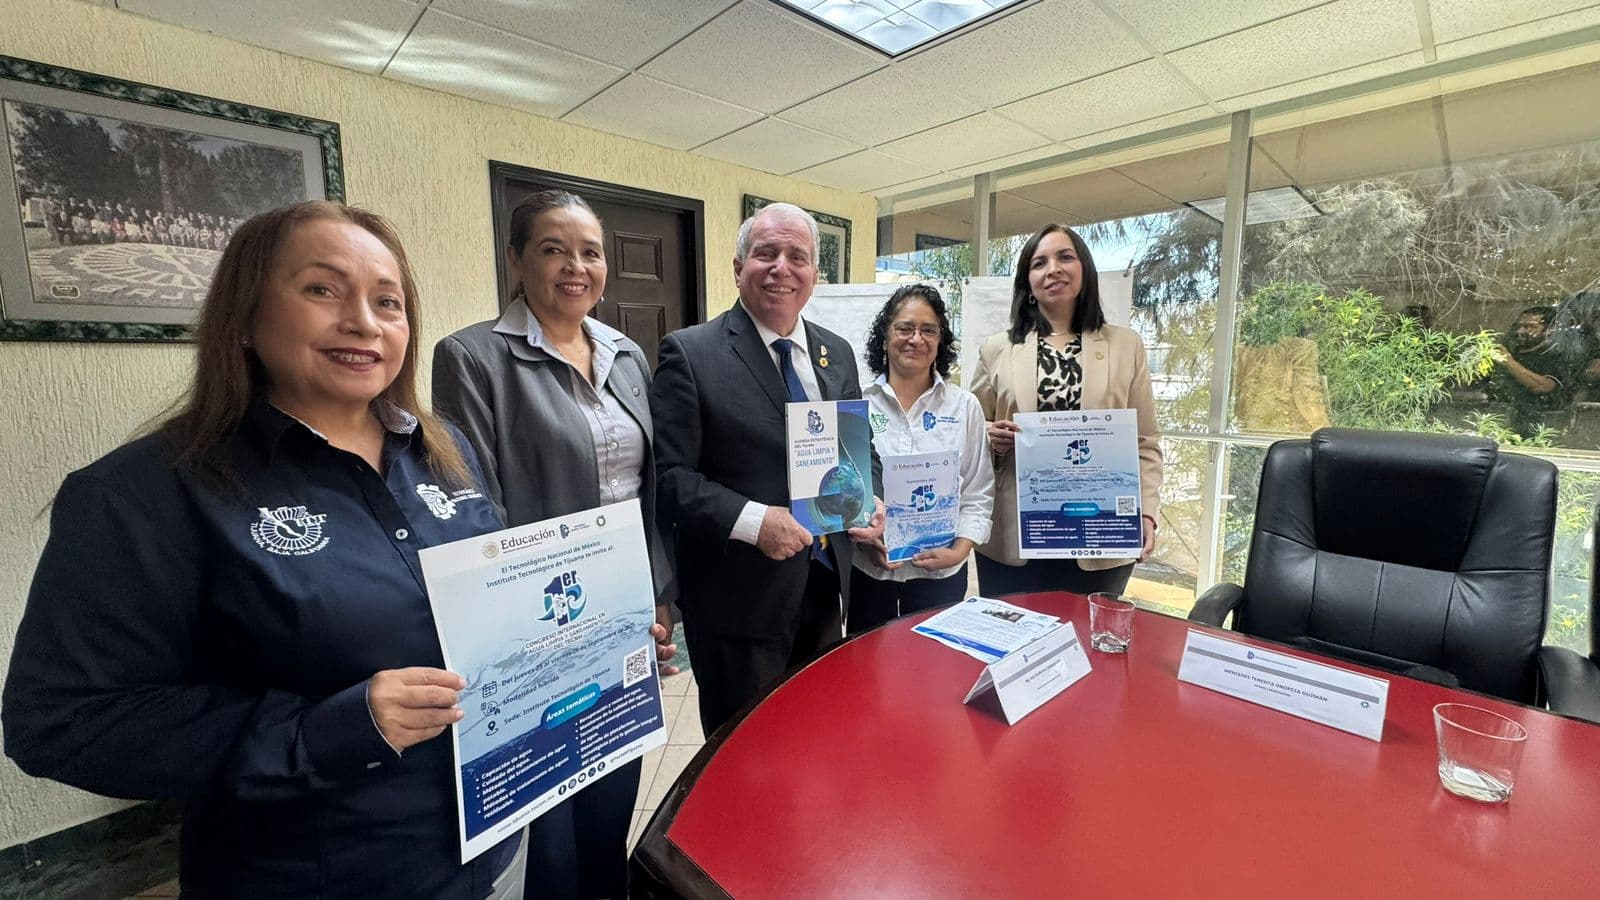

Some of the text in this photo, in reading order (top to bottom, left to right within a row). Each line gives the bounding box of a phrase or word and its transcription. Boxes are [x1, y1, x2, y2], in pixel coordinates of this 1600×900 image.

[812, 448, 830, 456] LIMPIA
[501, 527, 554, 548] Educación
[487, 575, 516, 587] Instituto
[518, 563, 553, 579] Tecnológico
[564, 554, 584, 564] Tijuana
[510, 556, 545, 571] Tecnológico
[548, 548, 572, 559] Nacional
[582, 540, 599, 549] México
[526, 632, 555, 647] CONGRESO
[558, 615, 596, 634] INTERNACIONAL
[528, 644, 543, 653] AGUA
[546, 636, 563, 646] LIMPIA
[569, 619, 604, 636] SANEAMIENTO
[514, 668, 534, 681] jueves
[1224, 668, 1251, 680] MERCEDES
[1252, 676, 1276, 687] TERESITA
[1276, 684, 1300, 694] OROPEZA
[503, 686, 536, 704] Modalidad
[504, 712, 520, 724] Sede:
[523, 698, 549, 714] Instituto
[551, 681, 583, 700] Tecnológico
[592, 667, 610, 679] Tijuana
[546, 691, 595, 721] Áreas temáticas
